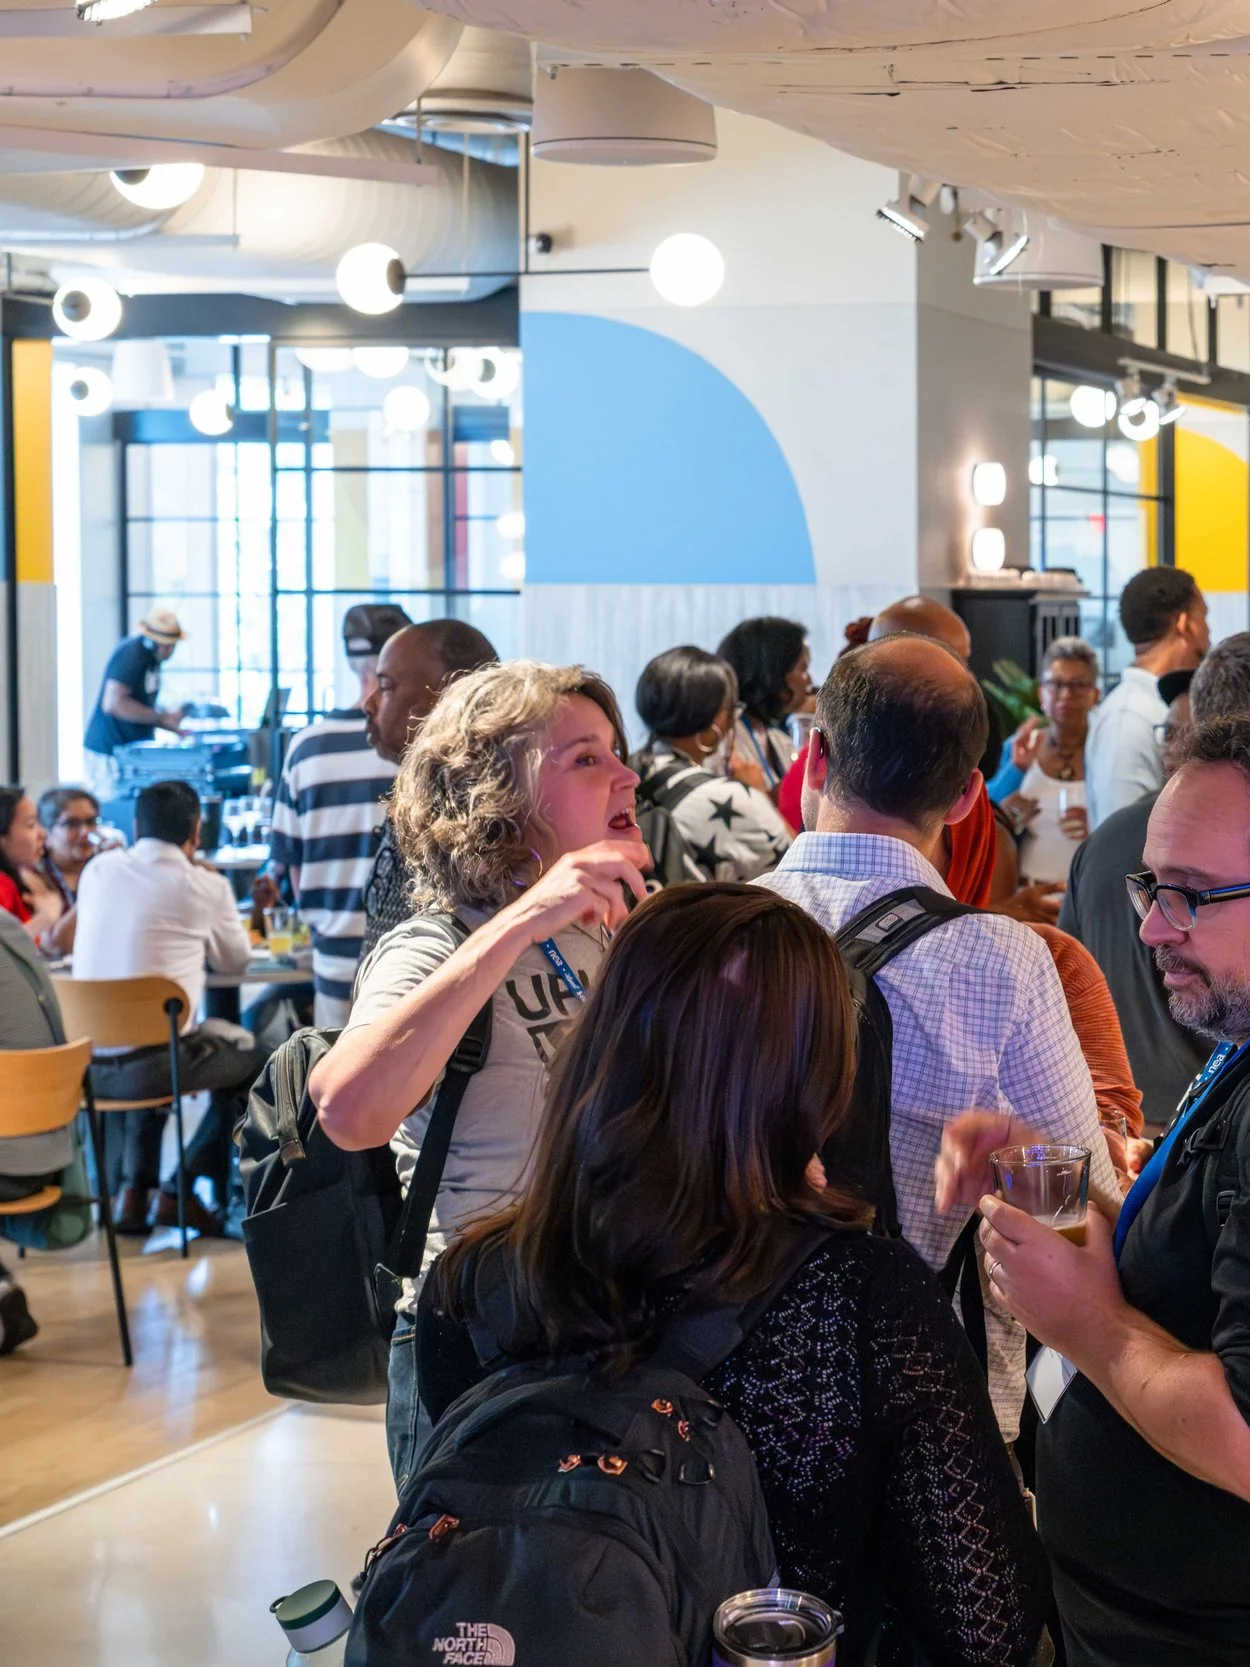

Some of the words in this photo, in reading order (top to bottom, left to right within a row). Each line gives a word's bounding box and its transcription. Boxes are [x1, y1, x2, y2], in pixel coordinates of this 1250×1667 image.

[1208, 1053, 1226, 1074] nea
[456, 1622, 487, 1637] THE
[432, 1637, 487, 1652] NORTH
[443, 1652, 485, 1666] FACE
